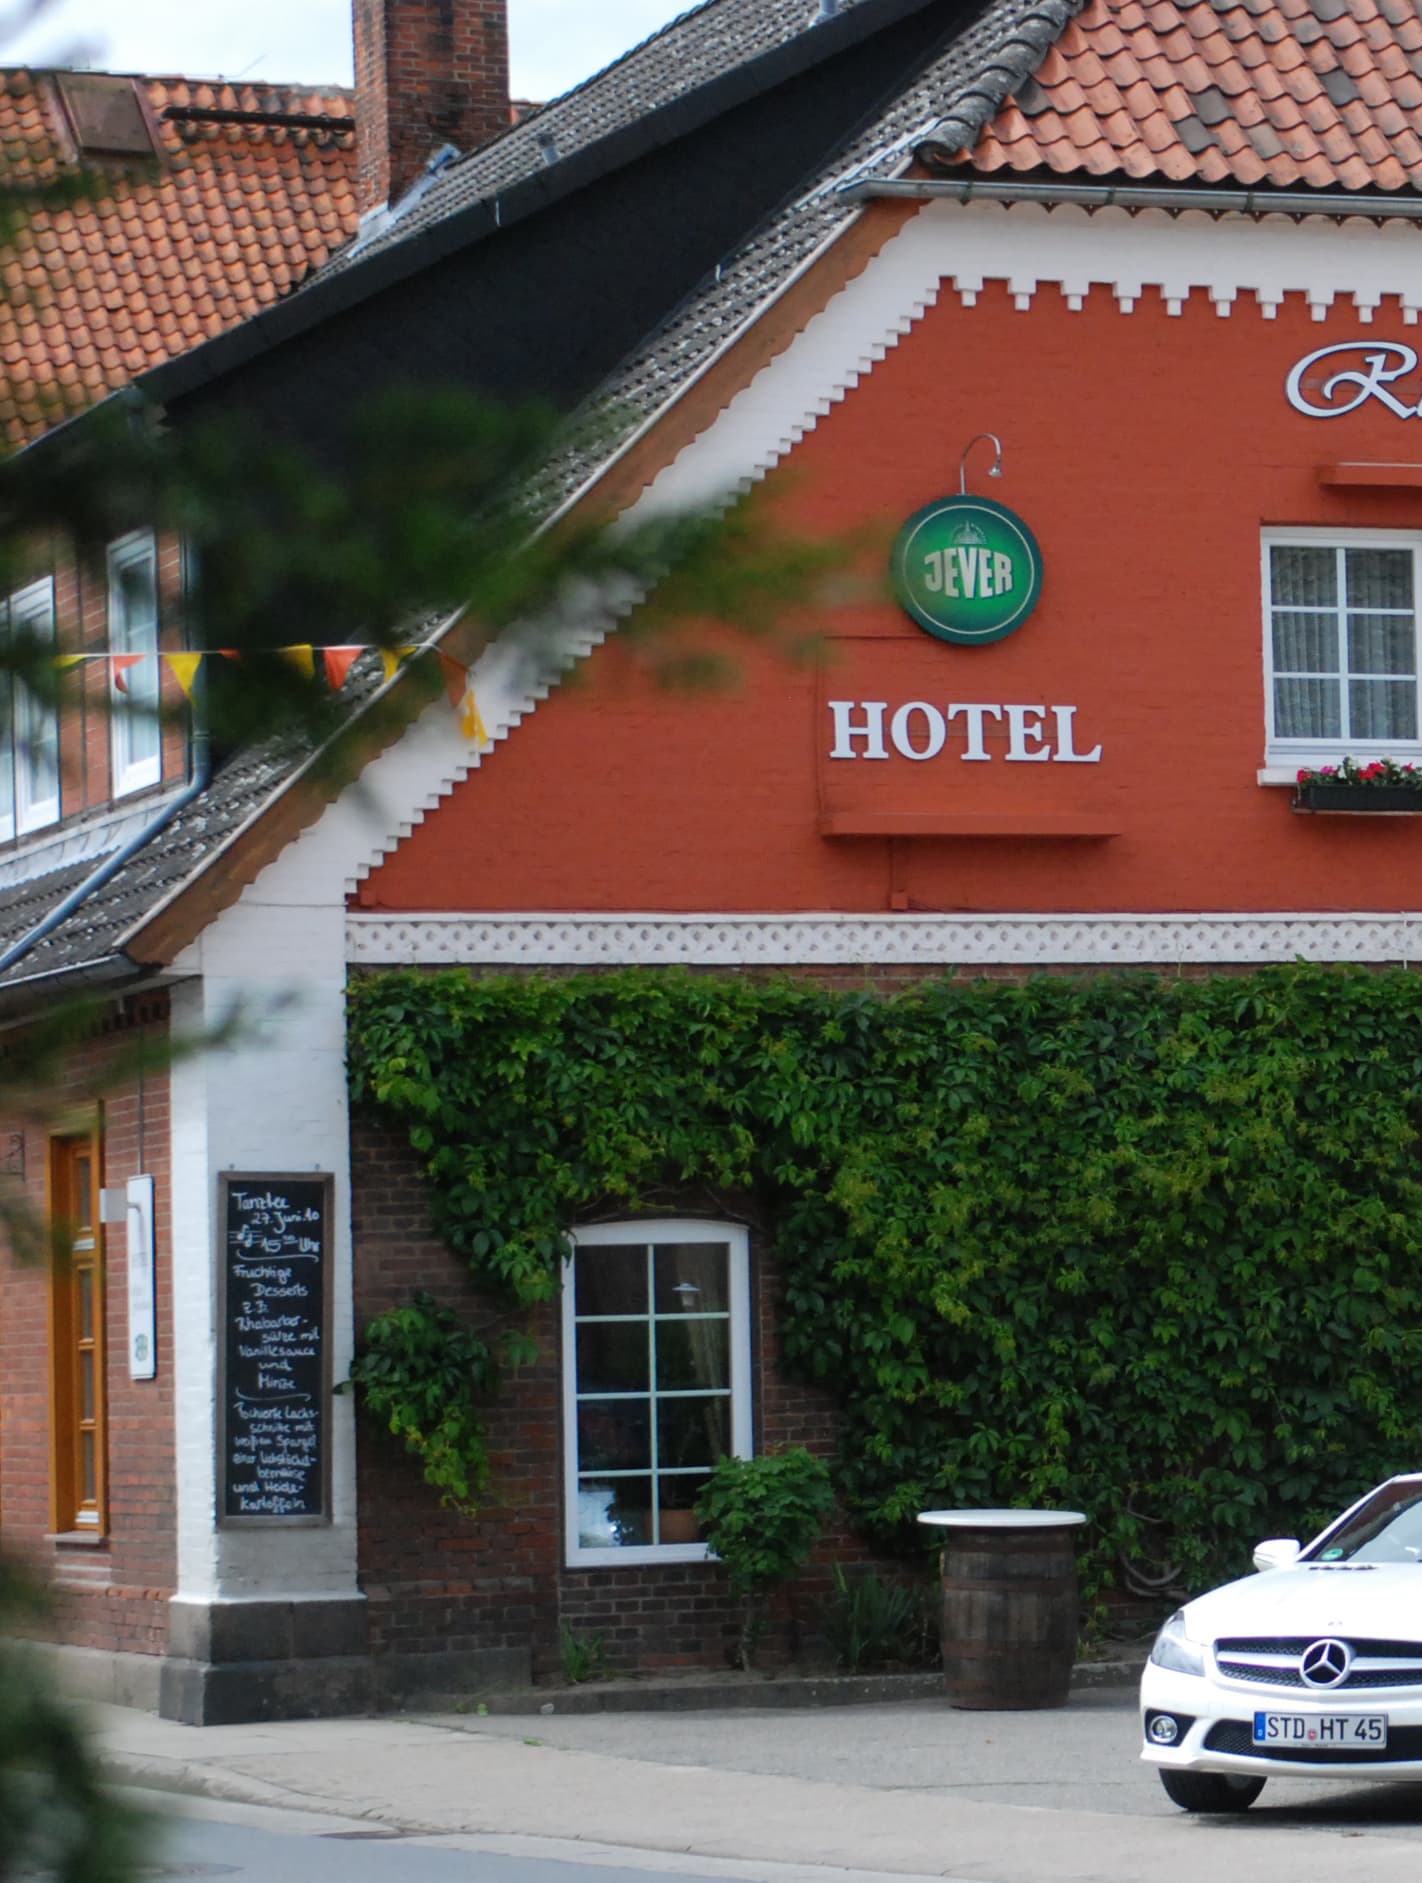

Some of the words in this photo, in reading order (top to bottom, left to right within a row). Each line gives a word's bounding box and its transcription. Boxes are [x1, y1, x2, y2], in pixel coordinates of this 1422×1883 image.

[924, 547, 1013, 599] JEVER
[828, 701, 1102, 762] HOTEL
[232, 1192, 290, 1210] Tanztee
[299, 1237, 320, 1252] Uhr
[232, 1264, 292, 1284] Fruchtige
[250, 1282, 309, 1297] Desserts
[300, 1326, 320, 1341] mit
[239, 1344, 316, 1357] Vanillesauce
[258, 1359, 293, 1371] und
[258, 1372, 296, 1389] Minze
[233, 1481, 260, 1493] und
[1267, 1716, 1305, 1739] STD
[1320, 1718, 1348, 1740] HT
[1354, 1719, 1382, 1741] 45
